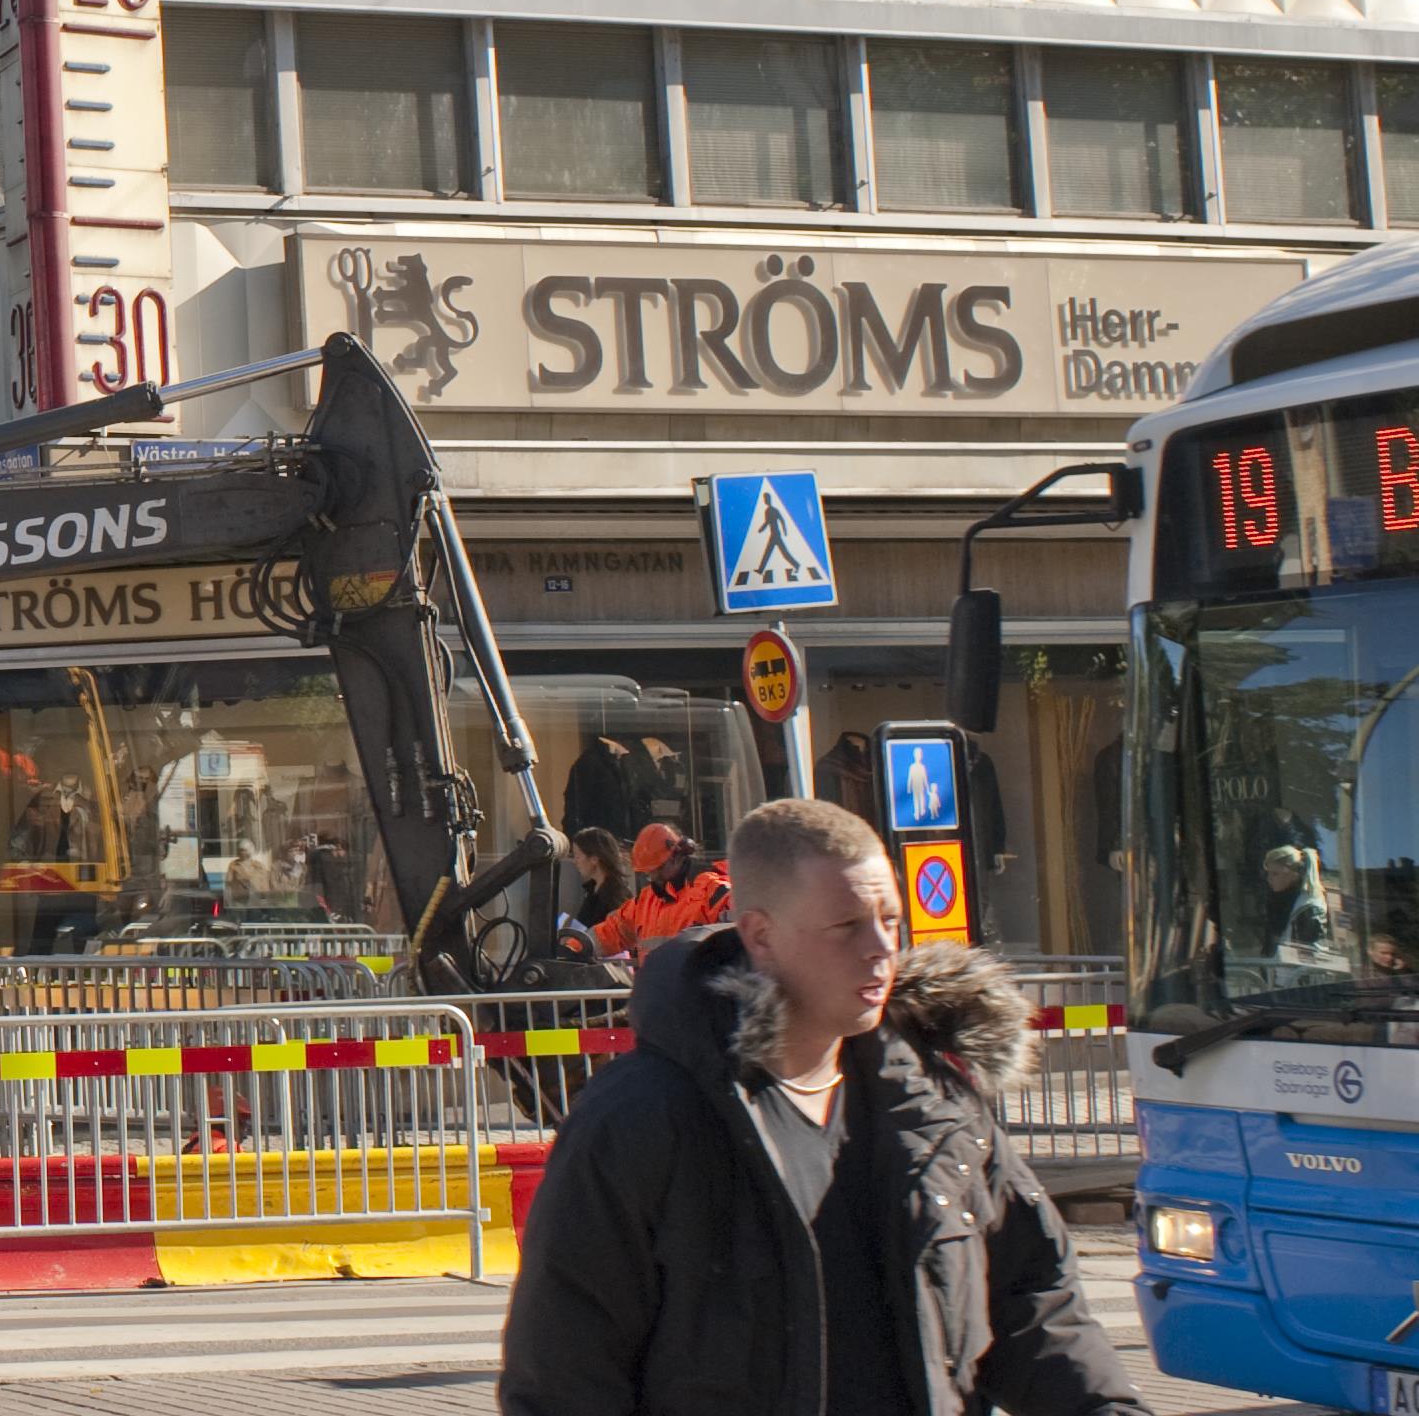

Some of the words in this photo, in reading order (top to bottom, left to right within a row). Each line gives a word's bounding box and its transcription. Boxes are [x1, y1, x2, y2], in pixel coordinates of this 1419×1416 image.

[89, 284, 170, 395] 30
[525, 253, 1023, 396] STRÖMS
[1068, 295, 1180, 343] Herr-
[1212, 447, 1279, 549] 19
[528, 551, 684, 574] HAMNGATAN
[190, 568, 305, 622] HÖR
[1284, 1152, 1363, 1174] VOLVO
